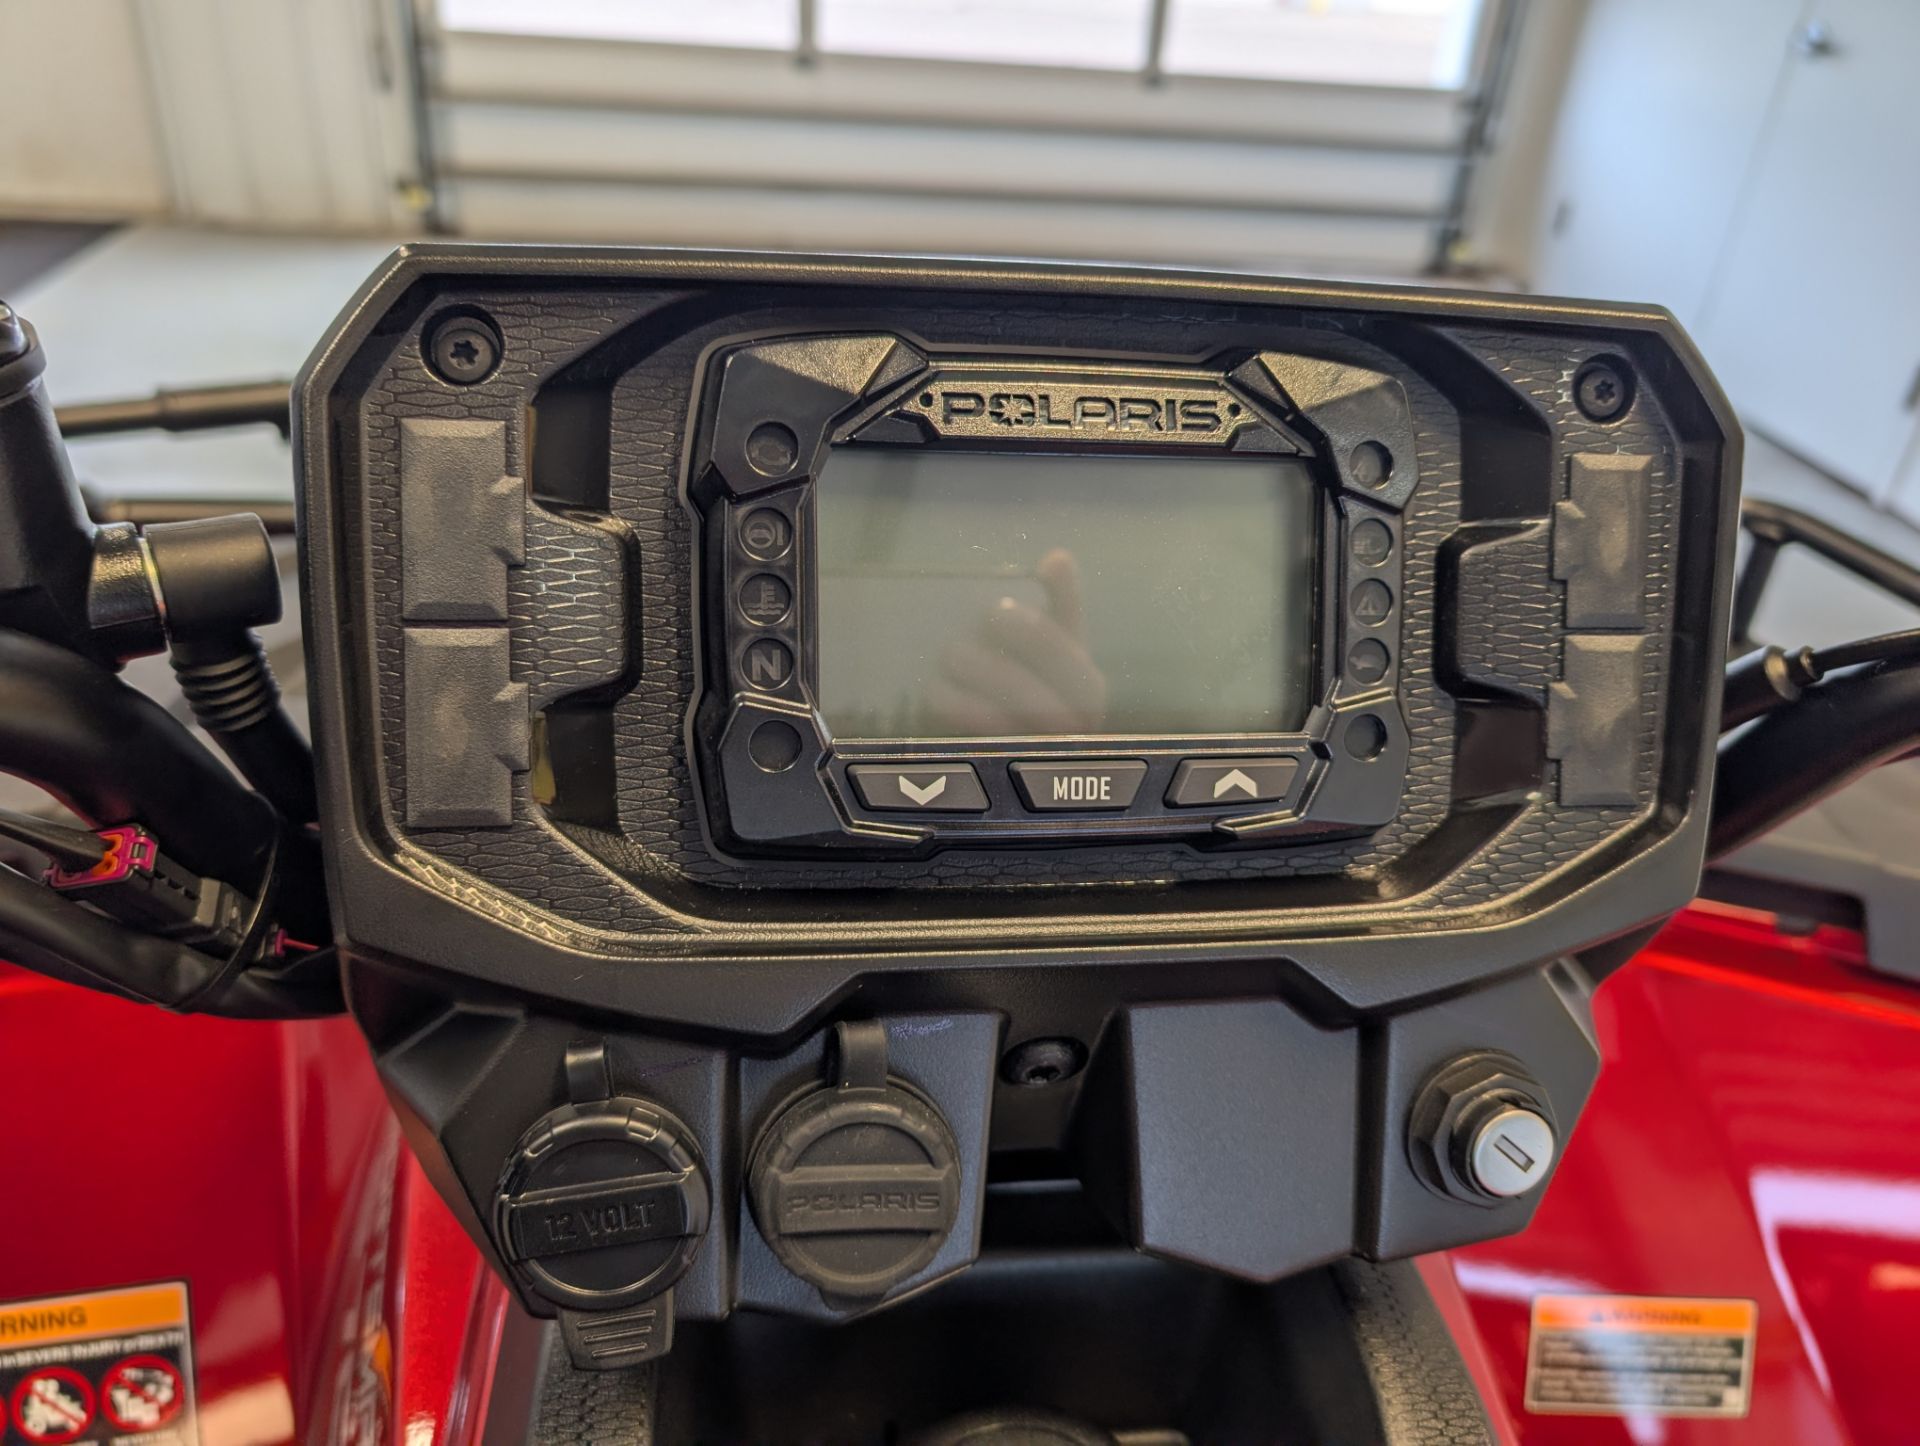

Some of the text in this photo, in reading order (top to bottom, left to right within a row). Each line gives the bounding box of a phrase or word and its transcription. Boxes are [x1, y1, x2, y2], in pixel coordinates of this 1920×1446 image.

[941, 391, 1222, 433] POLARIS
[751, 649, 783, 682] N
[1053, 776, 1111, 800] MODE
[545, 1201, 656, 1240] 12 VOLT
[786, 1192, 940, 1216] POLARIS
